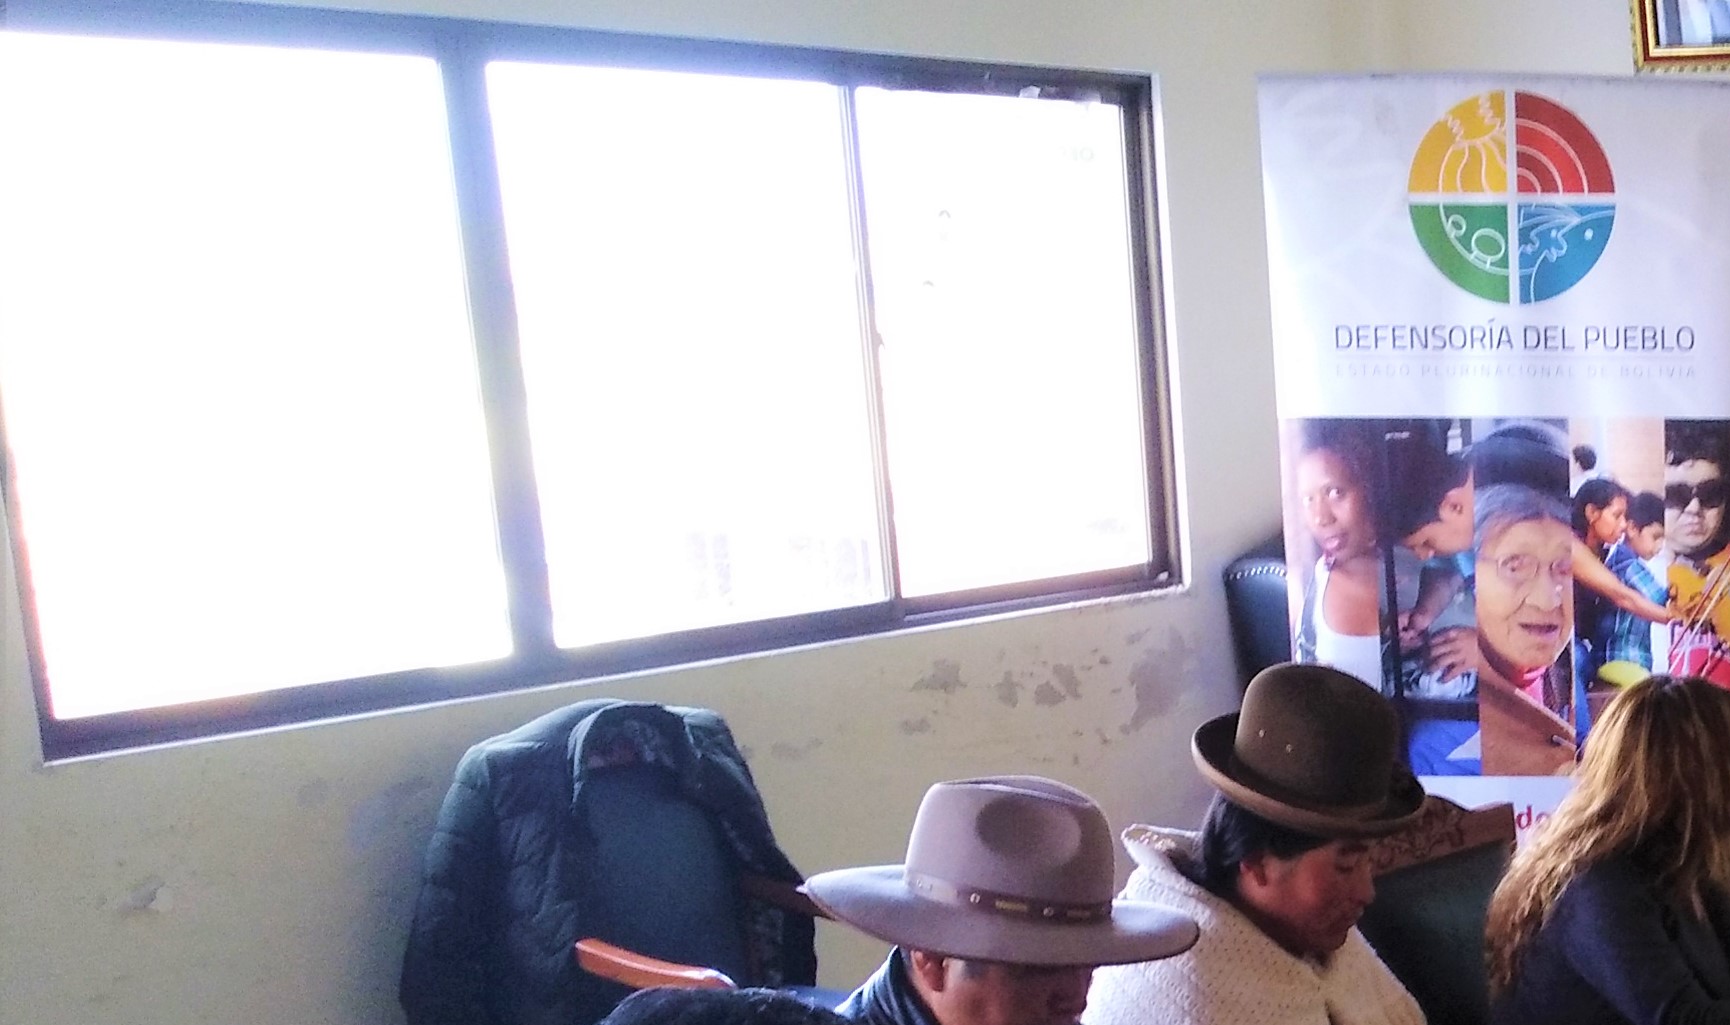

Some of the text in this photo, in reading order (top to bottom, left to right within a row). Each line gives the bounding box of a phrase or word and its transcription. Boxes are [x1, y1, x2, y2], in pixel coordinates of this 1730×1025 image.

[1334, 317, 1696, 351] DEFENSORÍA DEL PUEBLO
[1335, 363, 1696, 378] ESTADO PLURINACIONAL DE BOLIVIA
